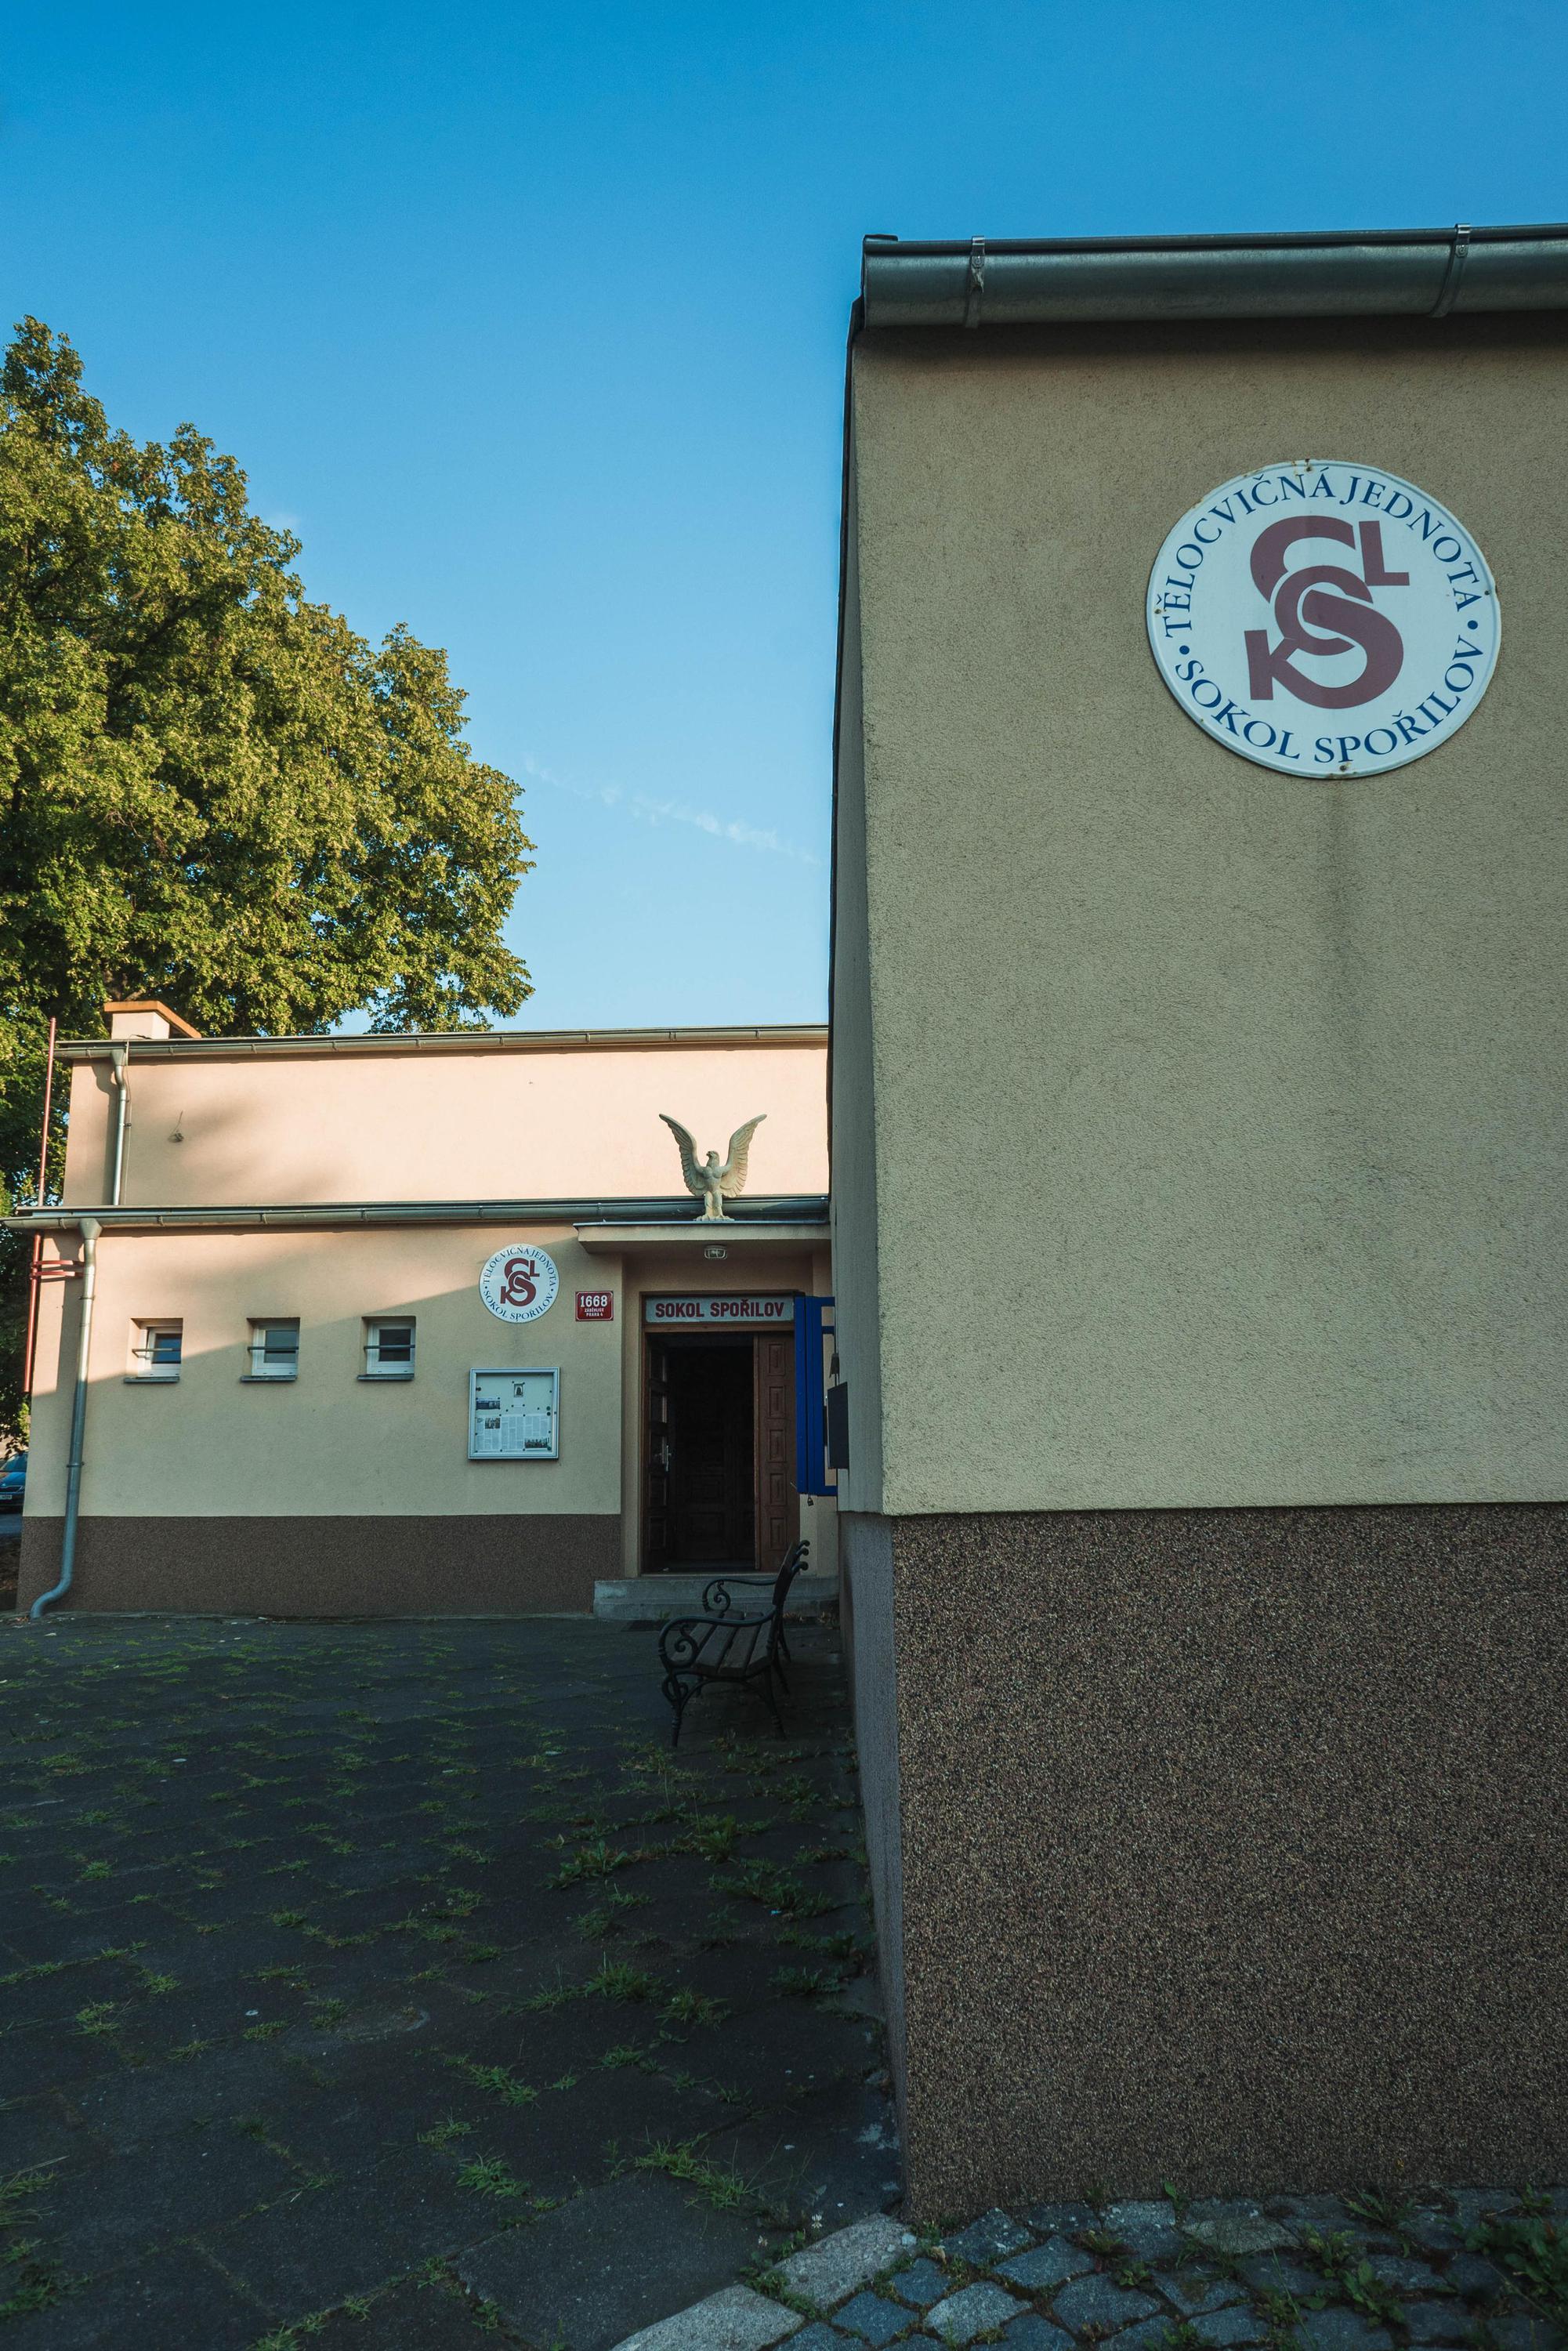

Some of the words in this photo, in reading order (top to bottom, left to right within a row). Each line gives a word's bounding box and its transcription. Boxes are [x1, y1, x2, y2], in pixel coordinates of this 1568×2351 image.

[1155, 466, 1335, 639] TĚLOCVIČNÁ
[1339, 475, 1483, 613] JEDNOTA
[1175, 659, 1301, 760] SOKOL
[1314, 635, 1484, 763] SPOŘILOV
[530, 1249, 556, 1286] JEDNOTA
[483, 1290, 508, 1318] SOKOL
[581, 1295, 607, 1307] 1668
[655, 1302, 704, 1318] SOKOL
[710, 1299, 784, 1317] SPOŘILOV
